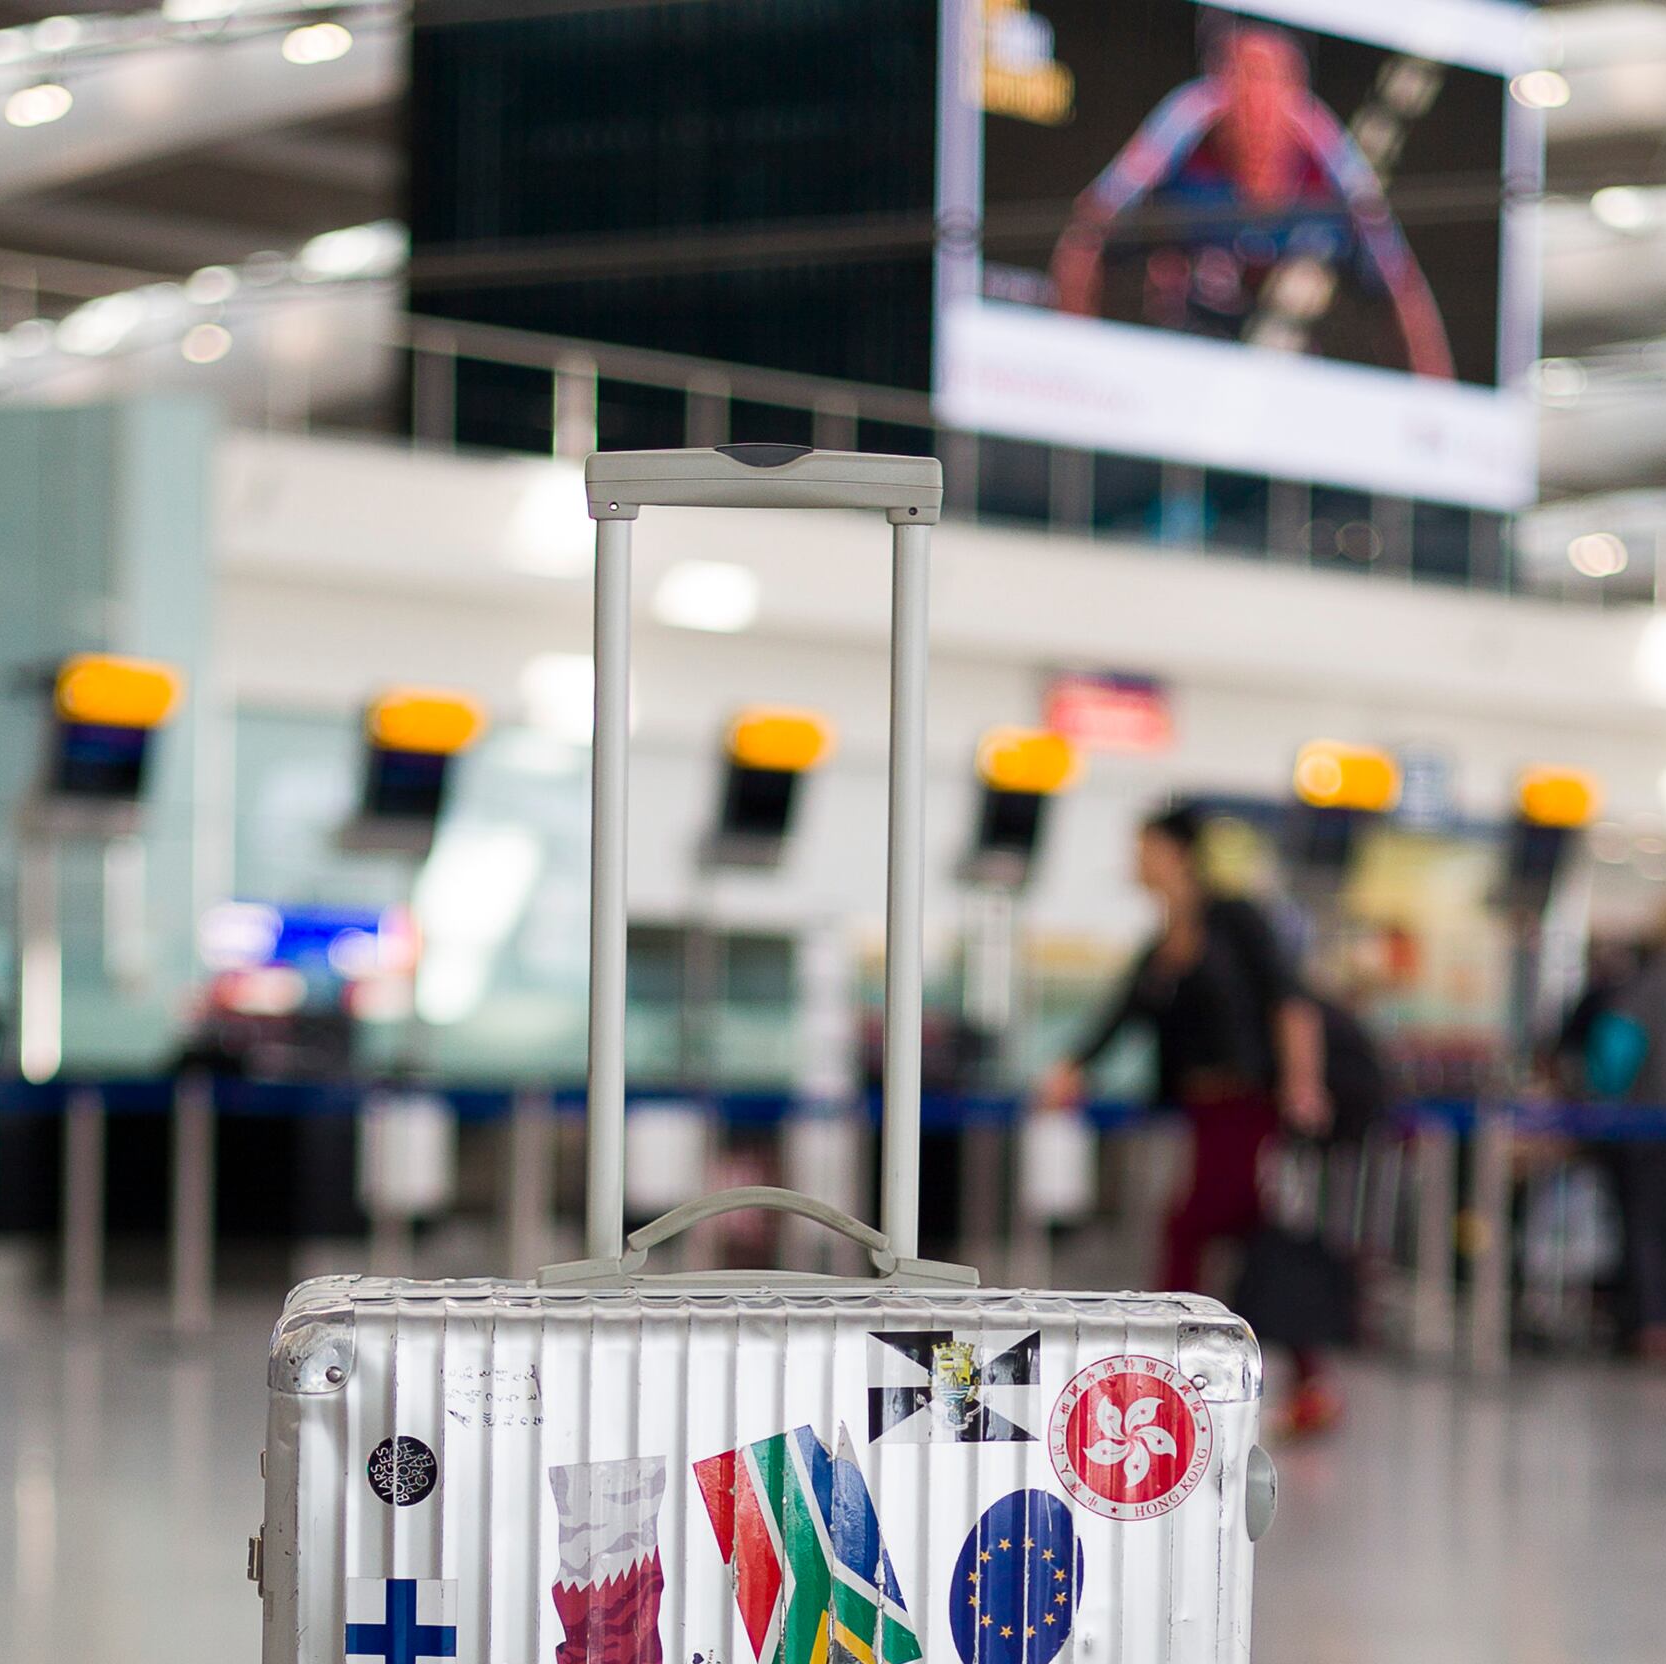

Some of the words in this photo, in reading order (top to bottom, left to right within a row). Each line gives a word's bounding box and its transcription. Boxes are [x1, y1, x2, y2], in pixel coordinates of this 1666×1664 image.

[370, 1464, 393, 1496] LARS
[1135, 1491, 1180, 1517] HONG
[1180, 1448, 1208, 1491] KONG
